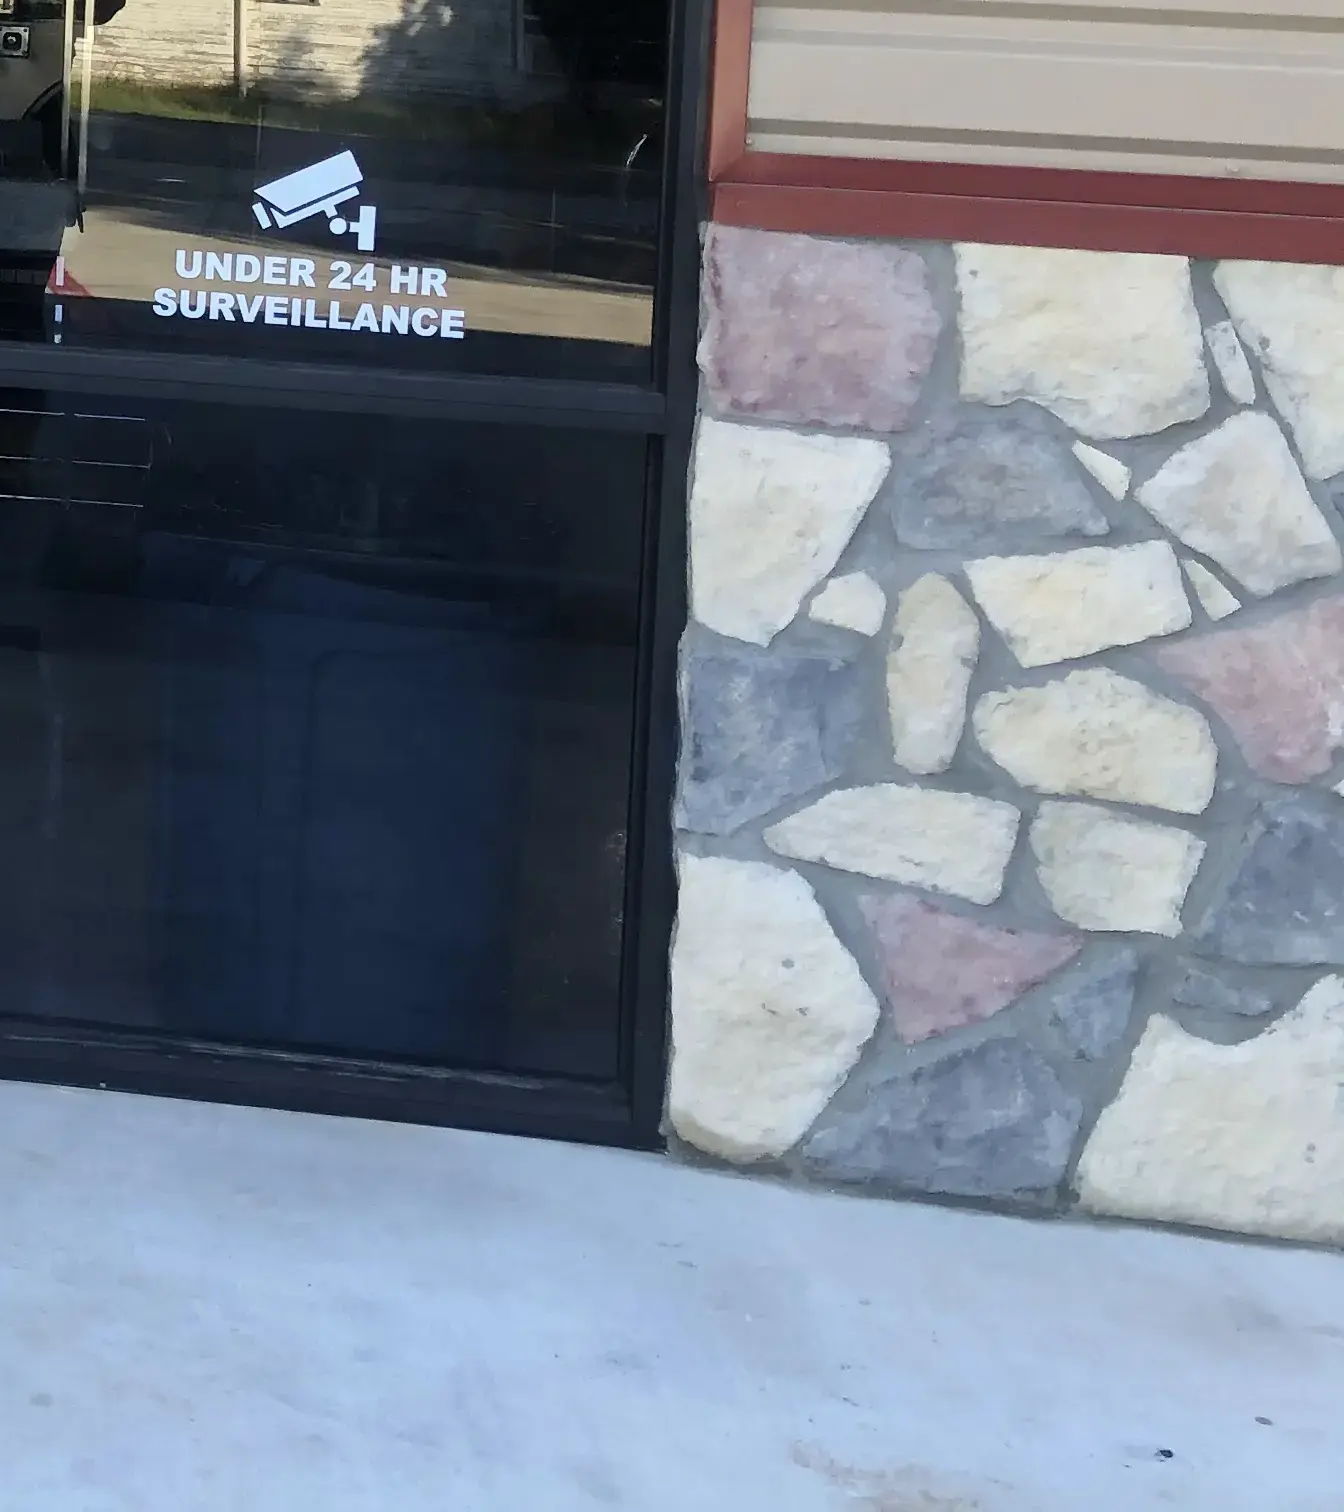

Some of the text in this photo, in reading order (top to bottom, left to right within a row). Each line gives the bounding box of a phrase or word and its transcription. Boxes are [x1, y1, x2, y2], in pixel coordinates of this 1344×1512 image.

[175, 249, 448, 298] UNDER 24 HR
[152, 287, 465, 340] SURVEILLANCE
